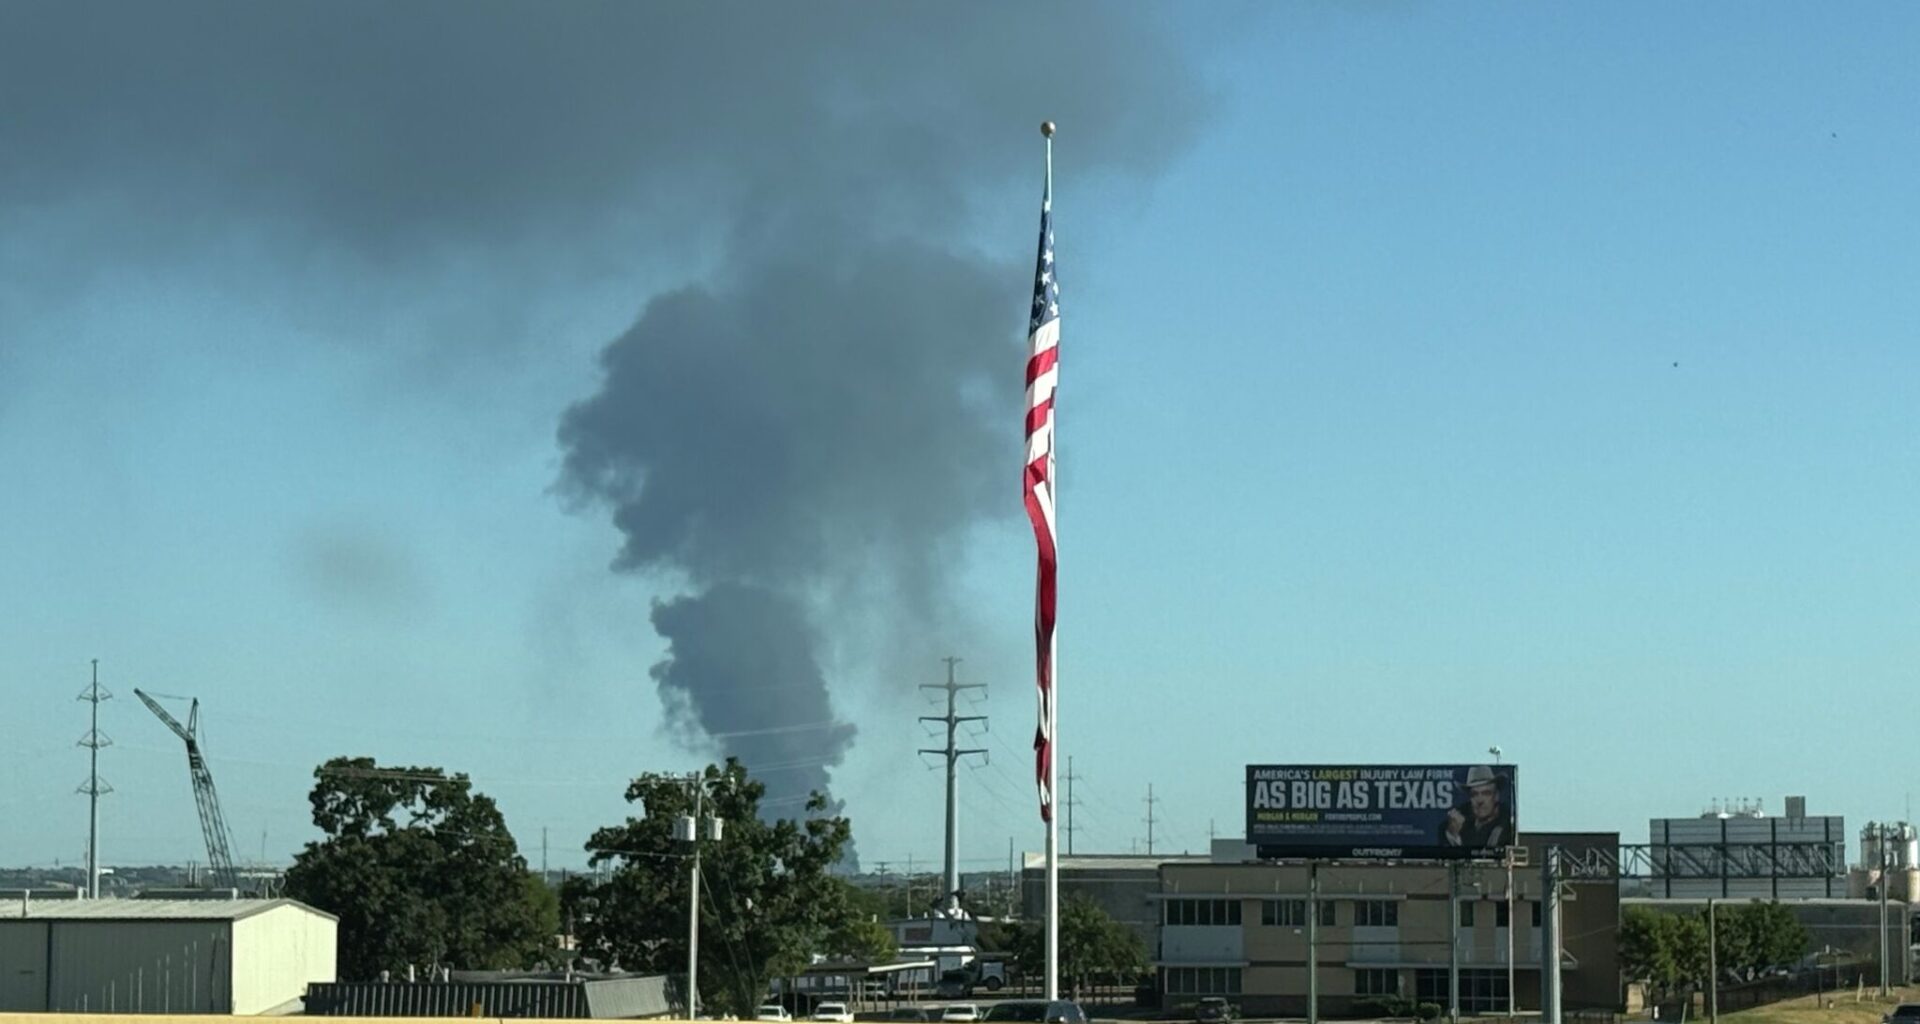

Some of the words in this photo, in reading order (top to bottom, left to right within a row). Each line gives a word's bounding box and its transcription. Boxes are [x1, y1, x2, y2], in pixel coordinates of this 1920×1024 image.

[1254, 770, 1310, 780] AMERICA'S
[1313, 770, 1357, 780] LARGEST
[1361, 770, 1398, 780] INJURY
[1400, 770, 1424, 780] LAW
[1427, 770, 1454, 780] FIRM
[1254, 781, 1285, 808] AS
[1291, 781, 1331, 808] BIG
[1337, 781, 1369, 808] AS
[1374, 781, 1453, 808] TEXAS
